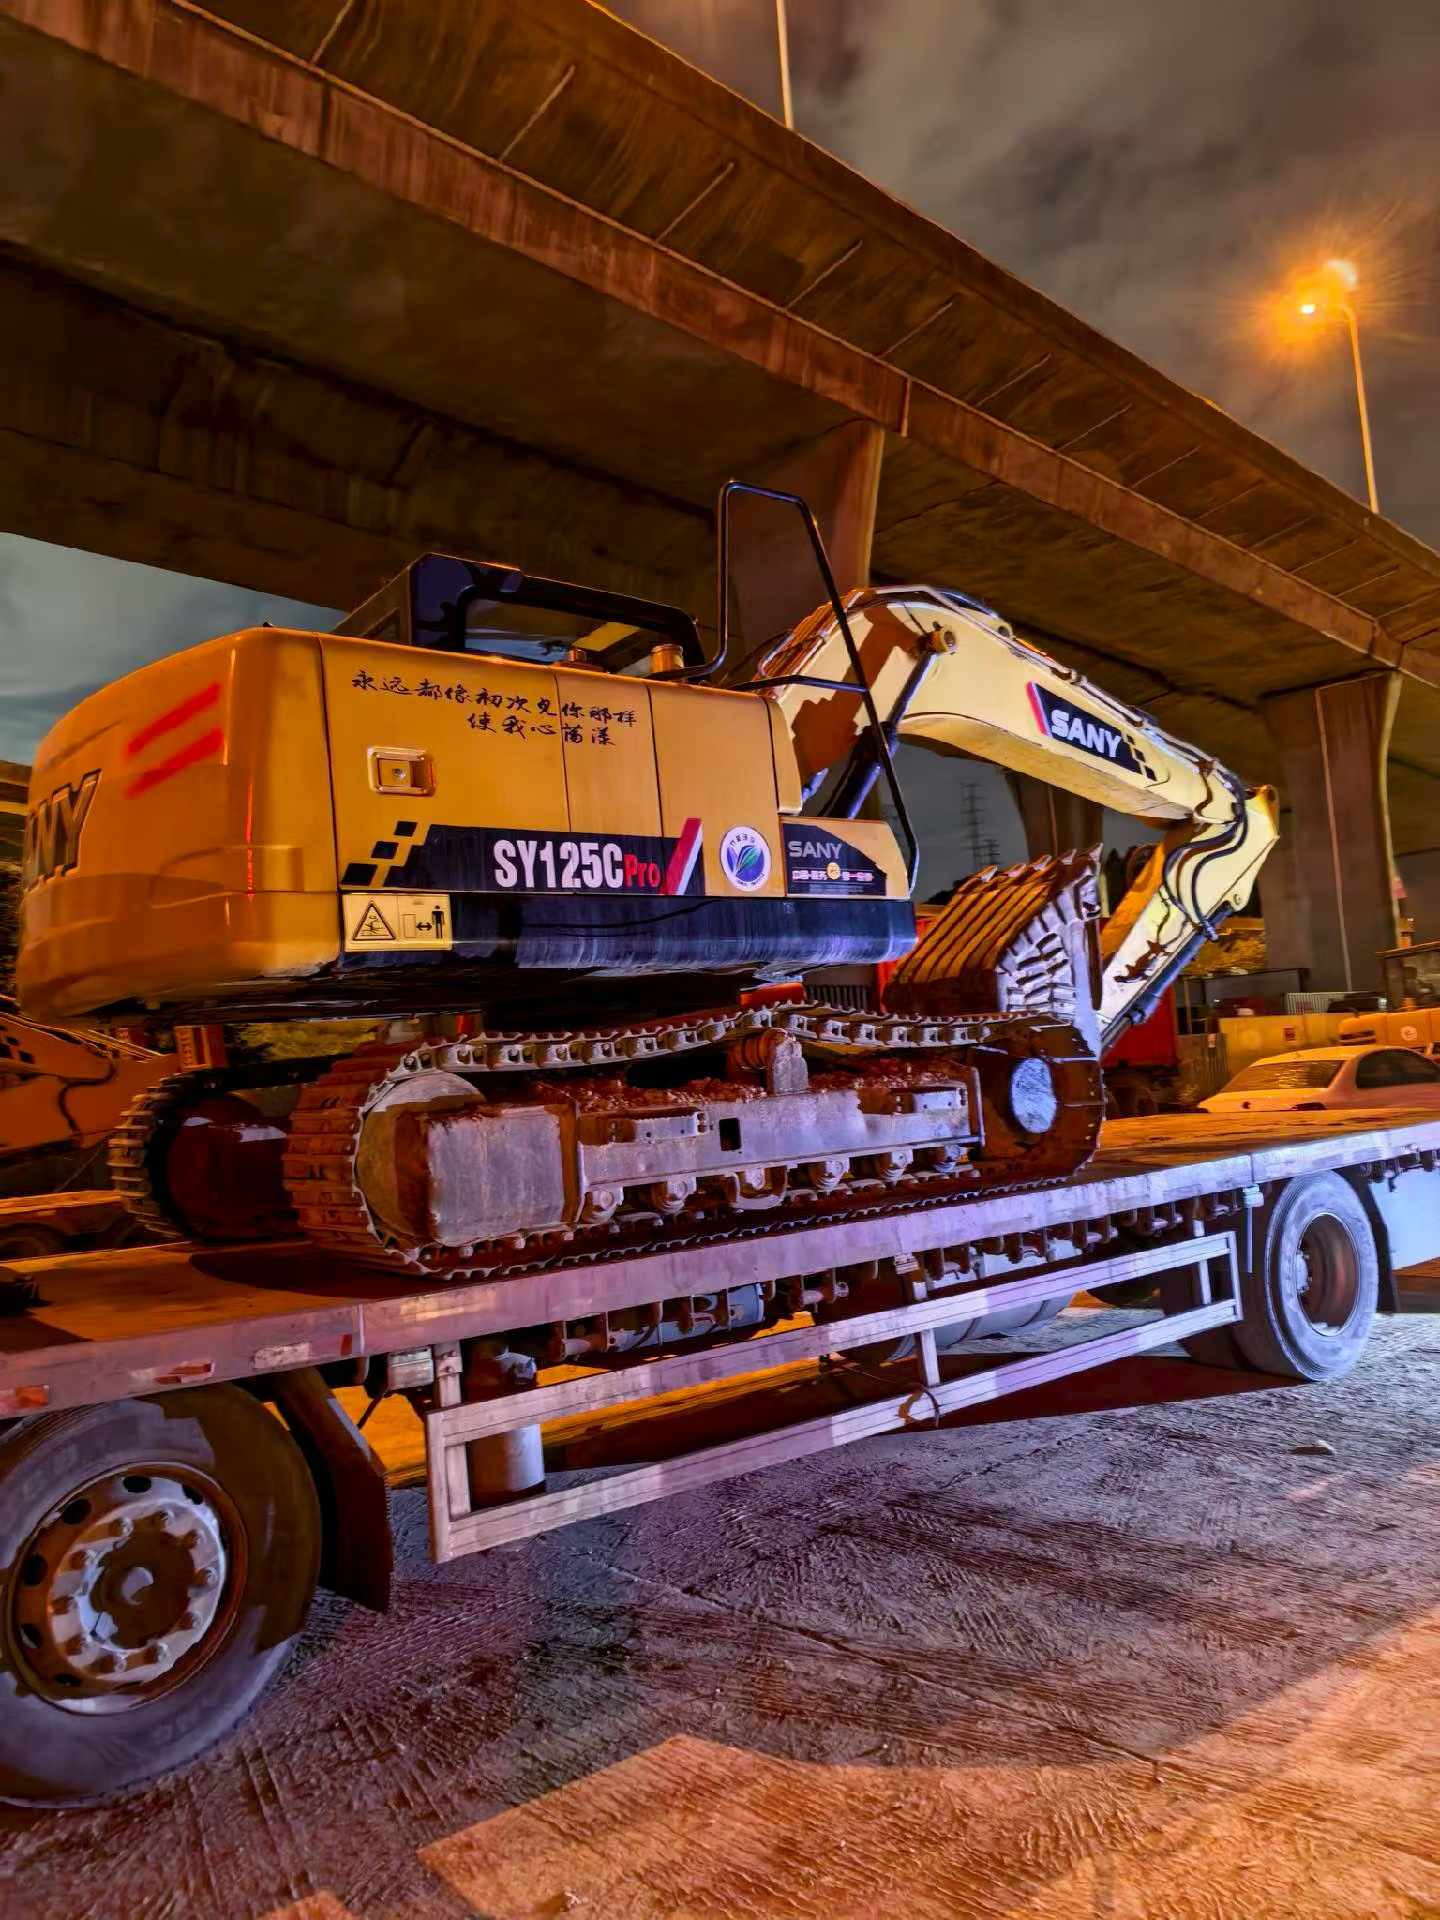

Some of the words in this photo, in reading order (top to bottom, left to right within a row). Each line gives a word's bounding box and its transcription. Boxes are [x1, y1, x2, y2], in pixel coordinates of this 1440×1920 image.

[352, 670, 636, 727] 永远都像初次见你那样
[466, 712, 615, 746] 使我心荡漾
[1051, 709, 1121, 758] SANY
[788, 840, 842, 859] SANY
